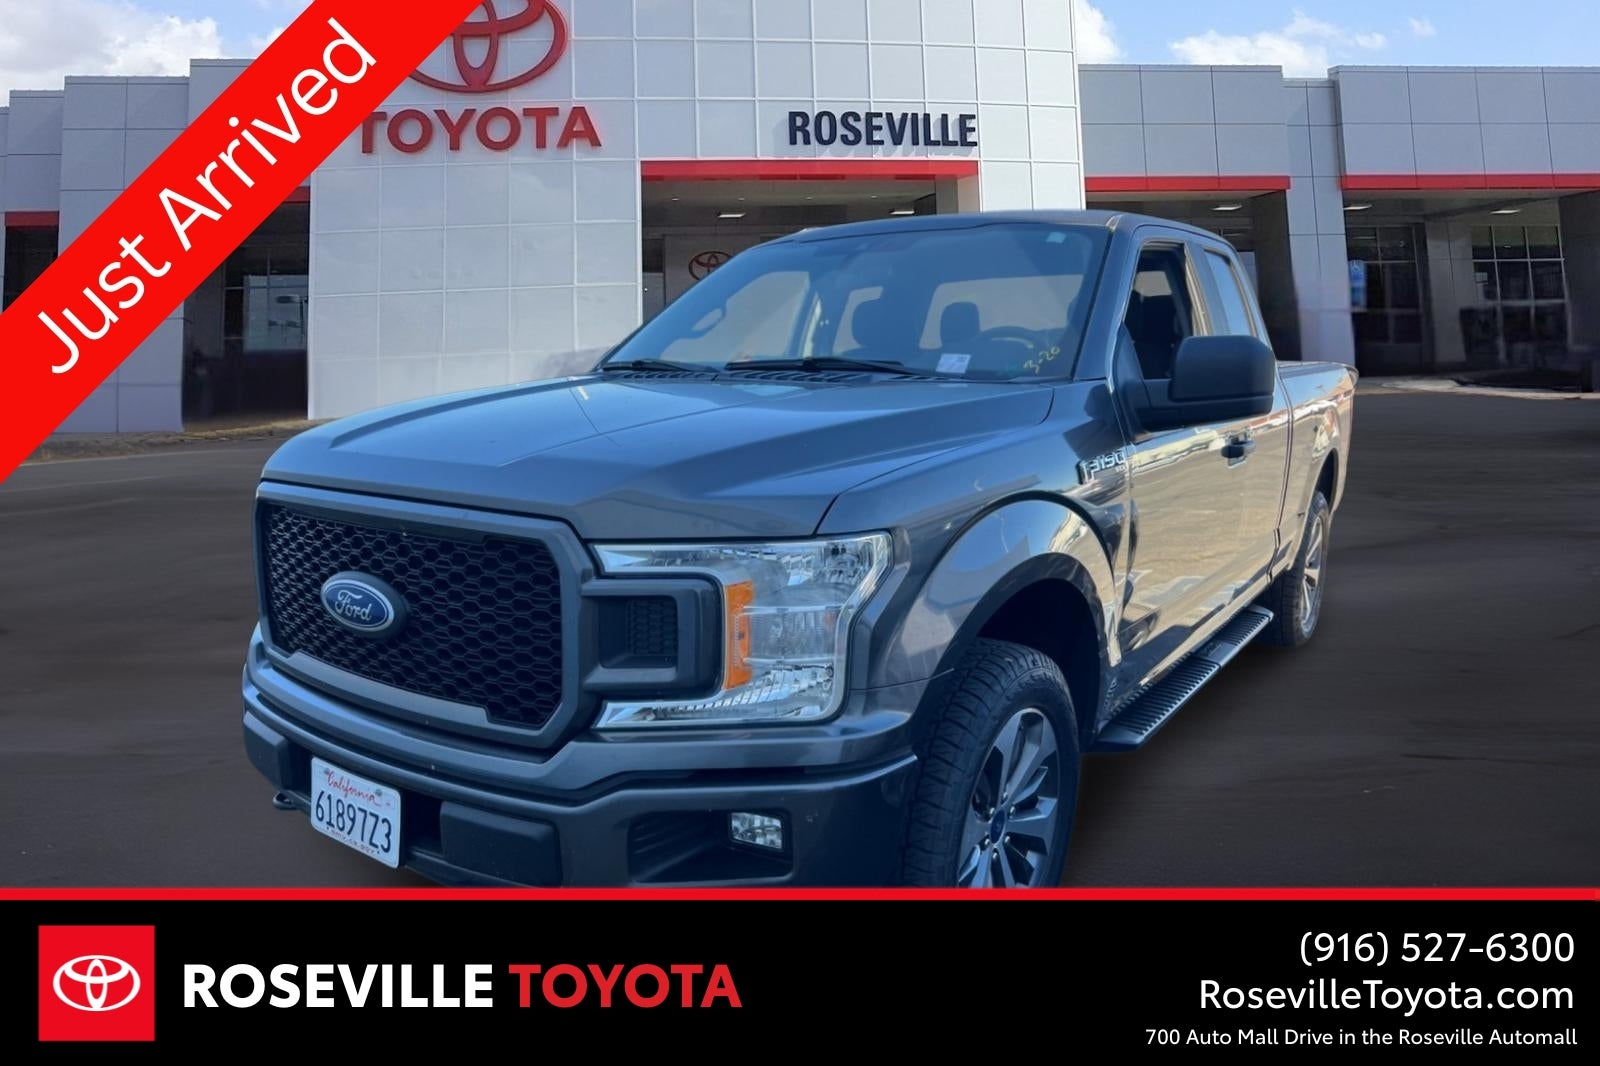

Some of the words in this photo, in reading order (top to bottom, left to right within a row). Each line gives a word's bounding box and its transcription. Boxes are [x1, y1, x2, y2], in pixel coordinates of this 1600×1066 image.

[361, 106, 602, 154] TOYOTA
[788, 110, 978, 147] ROSEVILLE
[335, 589, 373, 621] Ford
[326, 768, 382, 807] California
